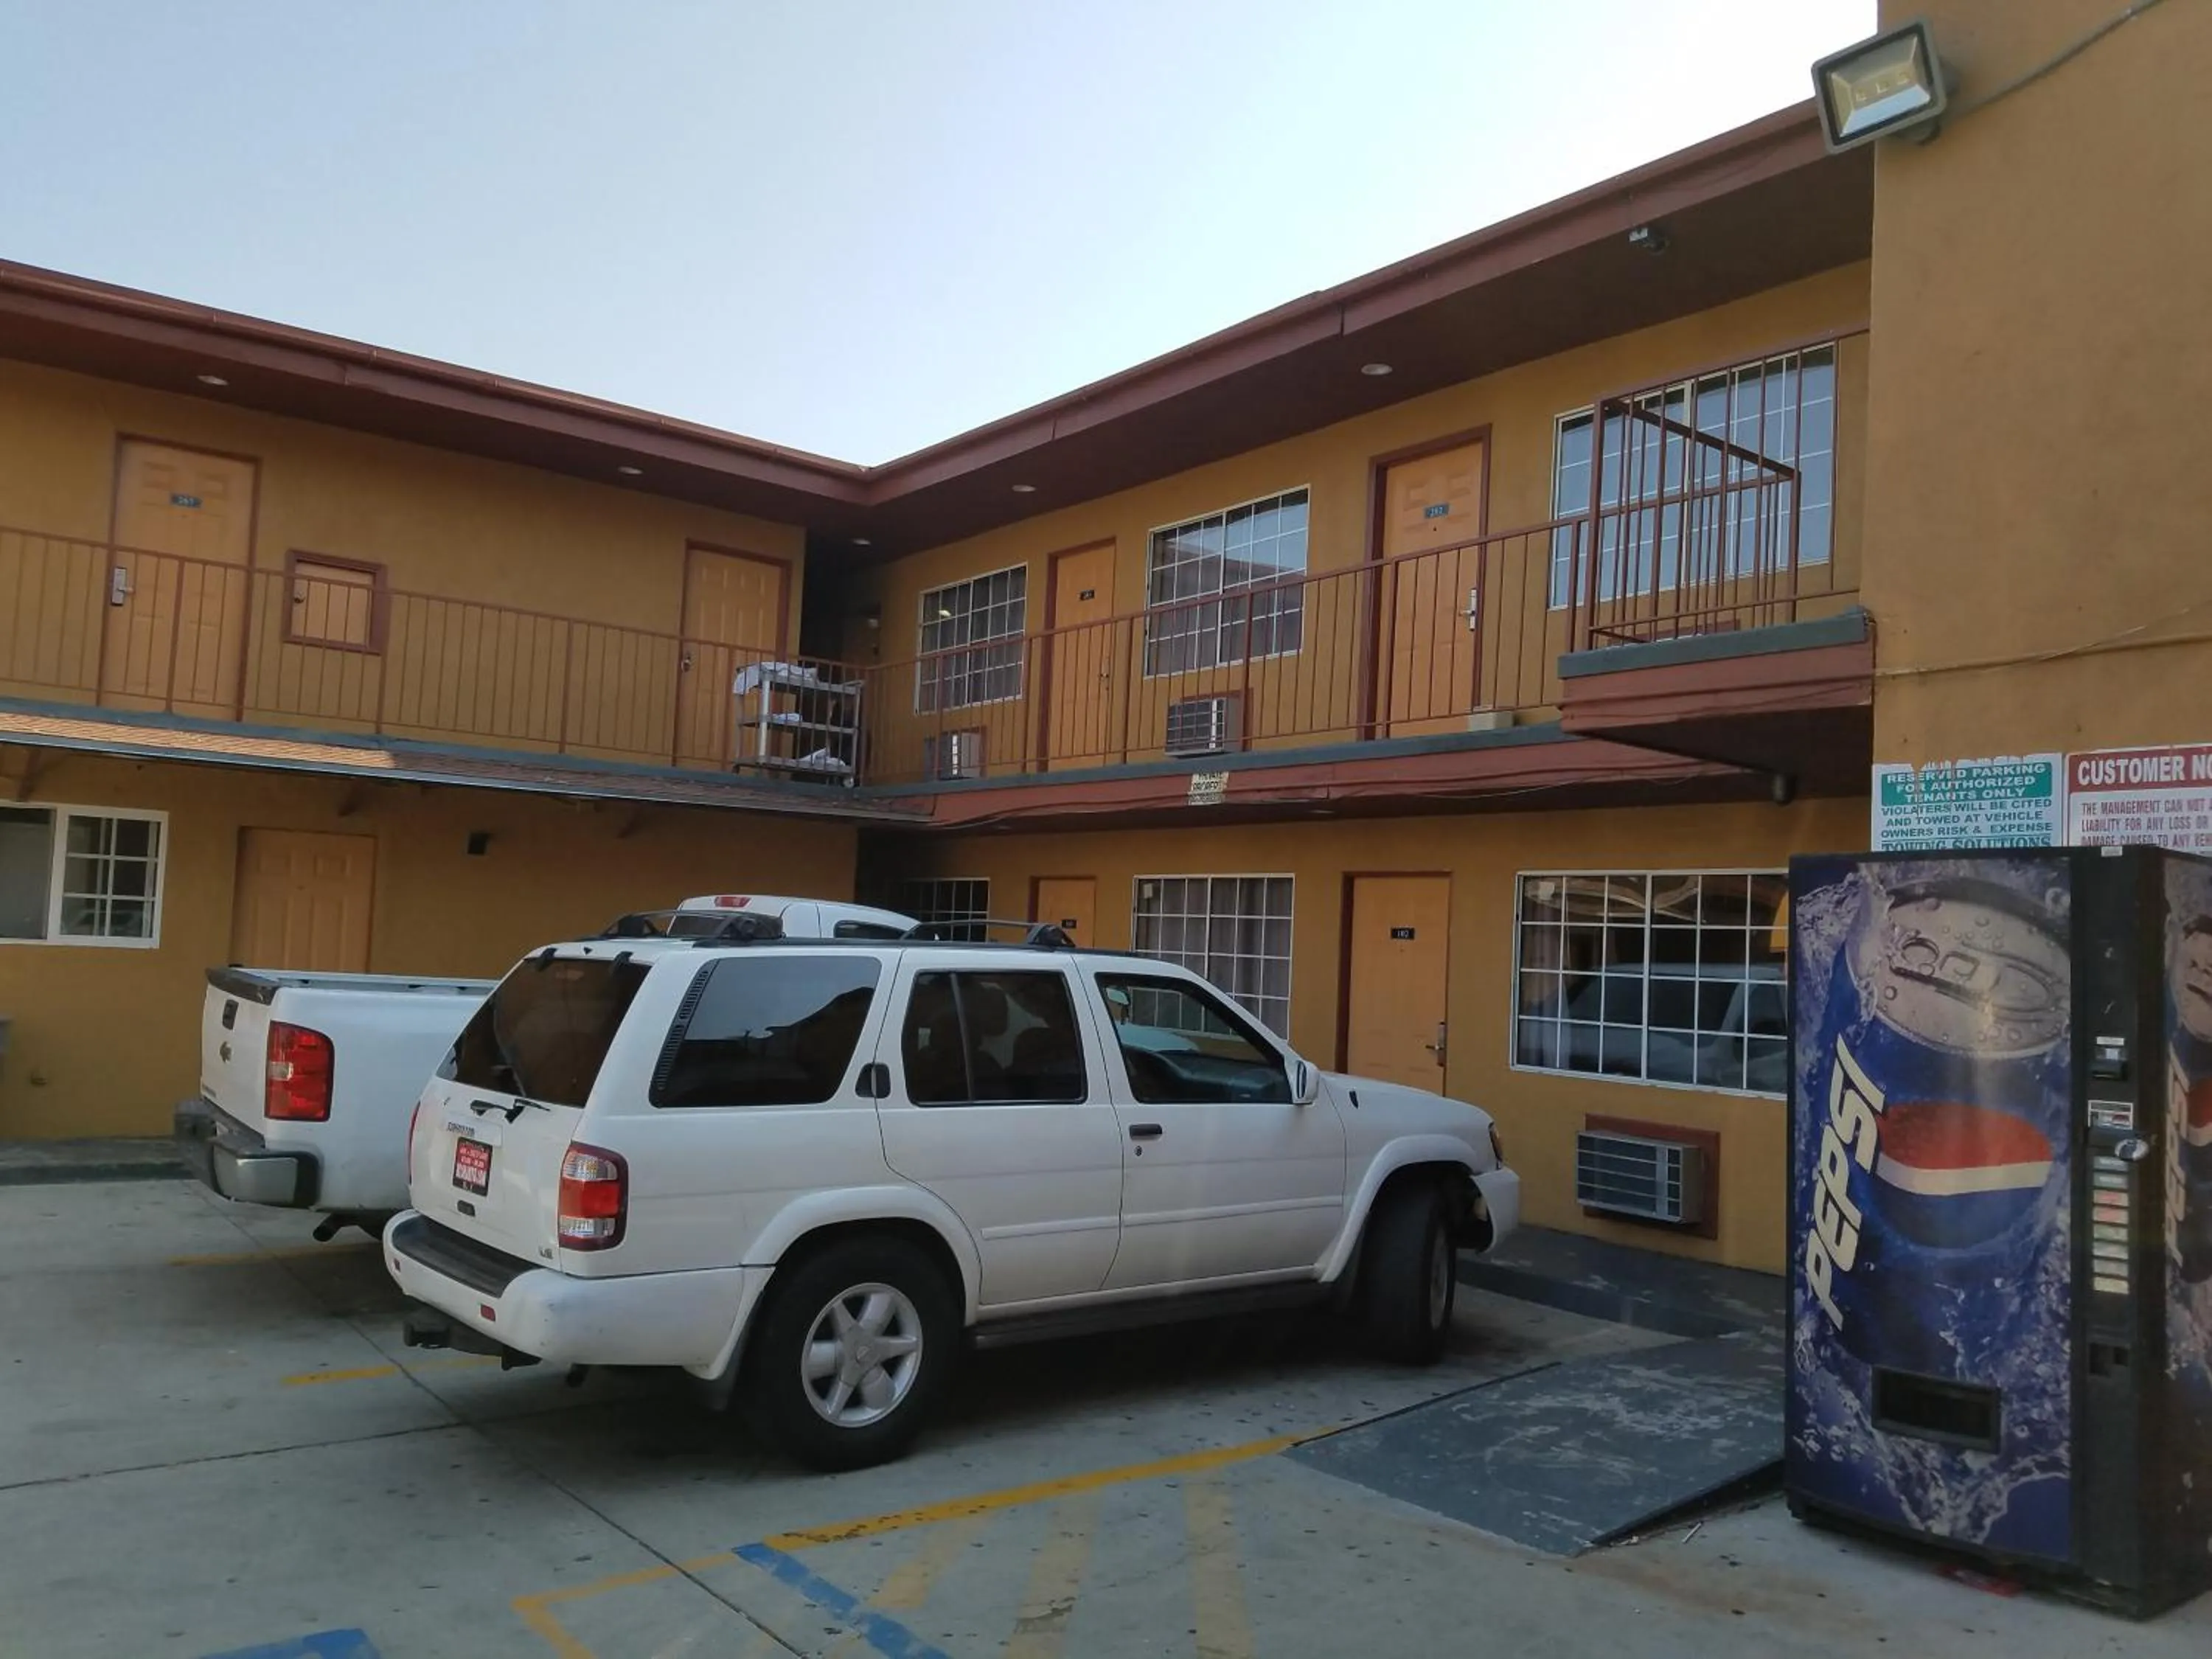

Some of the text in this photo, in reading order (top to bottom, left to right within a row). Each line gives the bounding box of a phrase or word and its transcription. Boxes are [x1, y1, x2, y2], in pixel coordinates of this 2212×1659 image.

[1972, 763, 2046, 778] PARKING
[2077, 755, 2185, 786] CUSTOMER
[1931, 776, 2035, 791] AUTHORIZED
[1981, 787, 2025, 799] ONLY
[1954, 801, 1985, 812] WILL
[1990, 800, 2007, 810] BE
[2011, 798, 2052, 809] CITED
[2081, 801, 2098, 815] THE
[2101, 799, 2161, 815] MANAGEMENT
[1886, 810, 2043, 827] AND TOWED AT VEHICLE
[2081, 817, 2121, 832] LIABILITY
[2124, 817, 2142, 831] FOR
[2146, 816, 2164, 830] ANY
[2168, 815, 2191, 830] LOSS
[1881, 821, 2053, 838] OWNERS RISK & EXPENSE
[2157, 833, 2168, 846] TO
[1806, 1032, 1885, 1332] PEPSI
